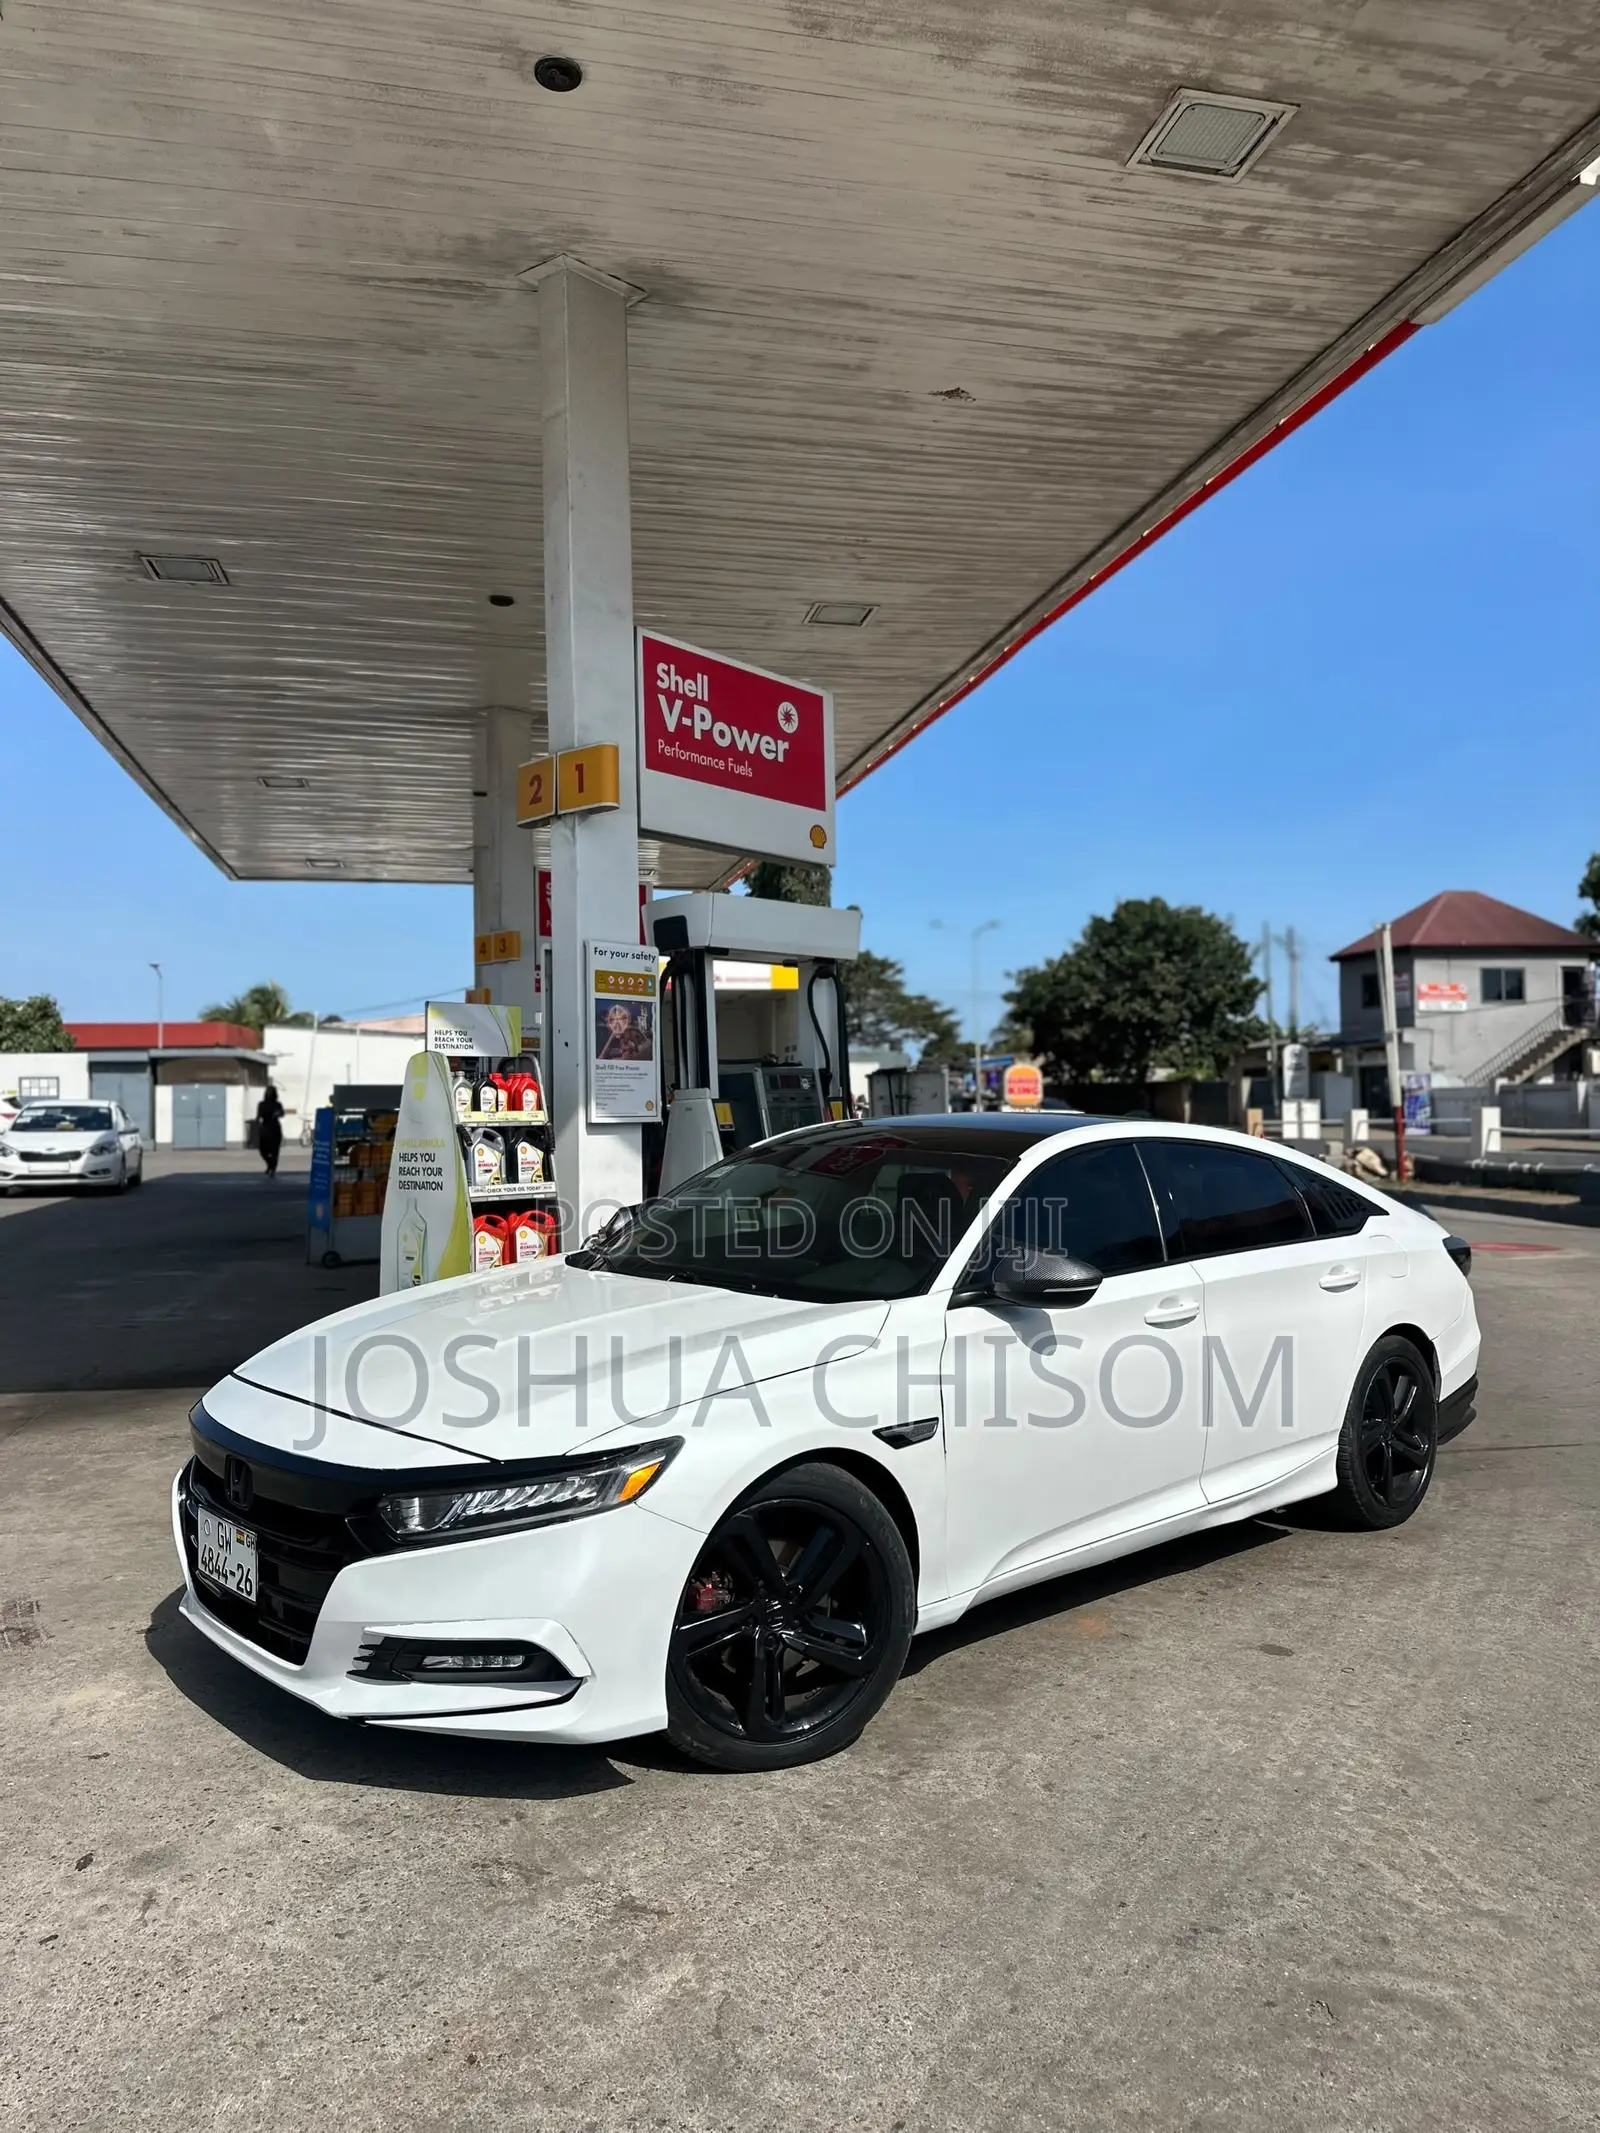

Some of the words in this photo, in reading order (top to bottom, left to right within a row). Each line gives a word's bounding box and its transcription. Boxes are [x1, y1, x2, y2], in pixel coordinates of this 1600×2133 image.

[656, 662, 708, 702] Shell
[657, 693, 790, 763] V-Power
[657, 739, 725, 770] Performance
[727, 756, 753, 778] Fuels
[528, 774, 543, 806] 2
[575, 762, 586, 794] 1
[499, 937, 507, 954] 3
[594, 947, 608, 956] For
[610, 950, 629, 960] your
[631, 951, 657, 964] safety
[398, 1152, 419, 1163] HELPS
[420, 1152, 436, 1163] YOU
[398, 1166, 421, 1177] REACH
[422, 1166, 443, 1177] YOUR
[398, 1180, 444, 1191] DESTINATION
[201, 1543, 253, 1597] 4844-26
